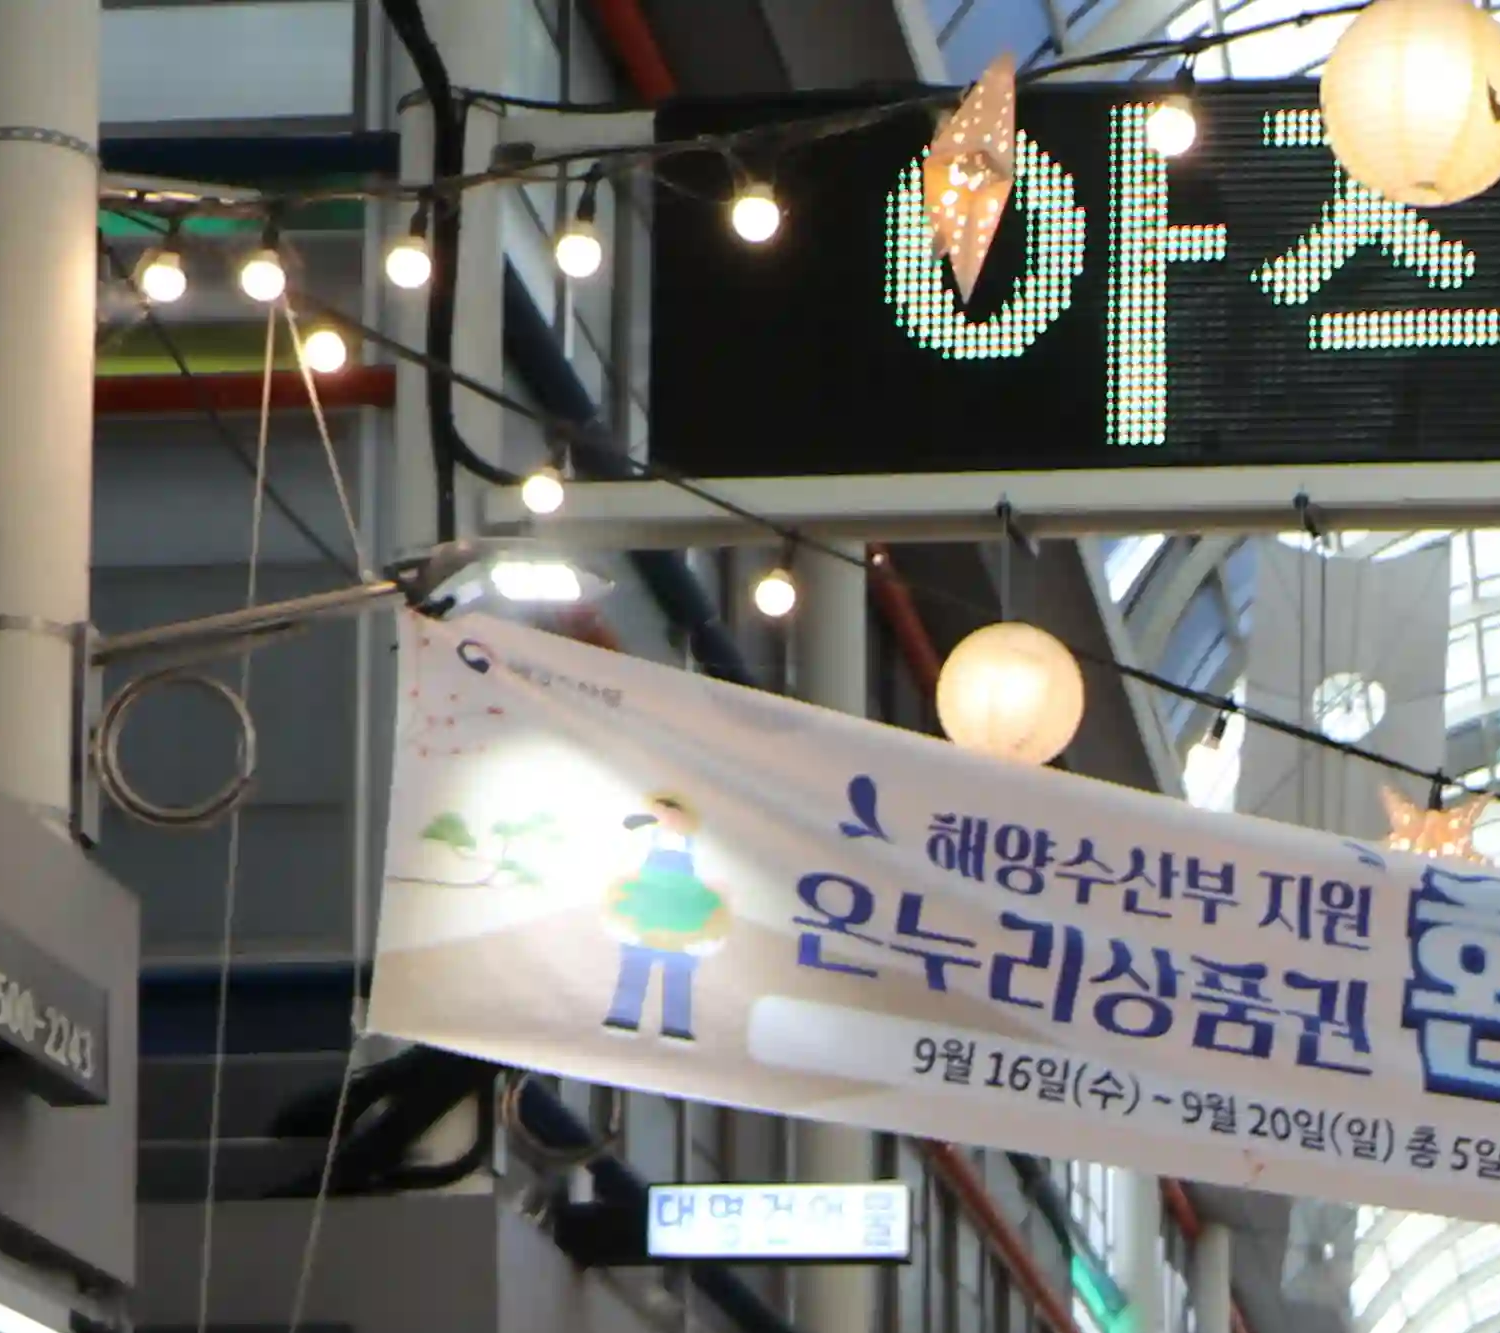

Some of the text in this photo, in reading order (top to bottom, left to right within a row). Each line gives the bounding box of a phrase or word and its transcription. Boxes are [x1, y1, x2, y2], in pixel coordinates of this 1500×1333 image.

[926, 812, 1373, 952] 해양수산부 지원
[793, 870, 1375, 1077] 온누리상품권
[912, 1037, 974, 1086] 9월
[988, 1049, 1141, 1117] 16일(수)
[1248, 1104, 1396, 1164] 20일(일)
[1405, 1125, 1442, 1169] 총
